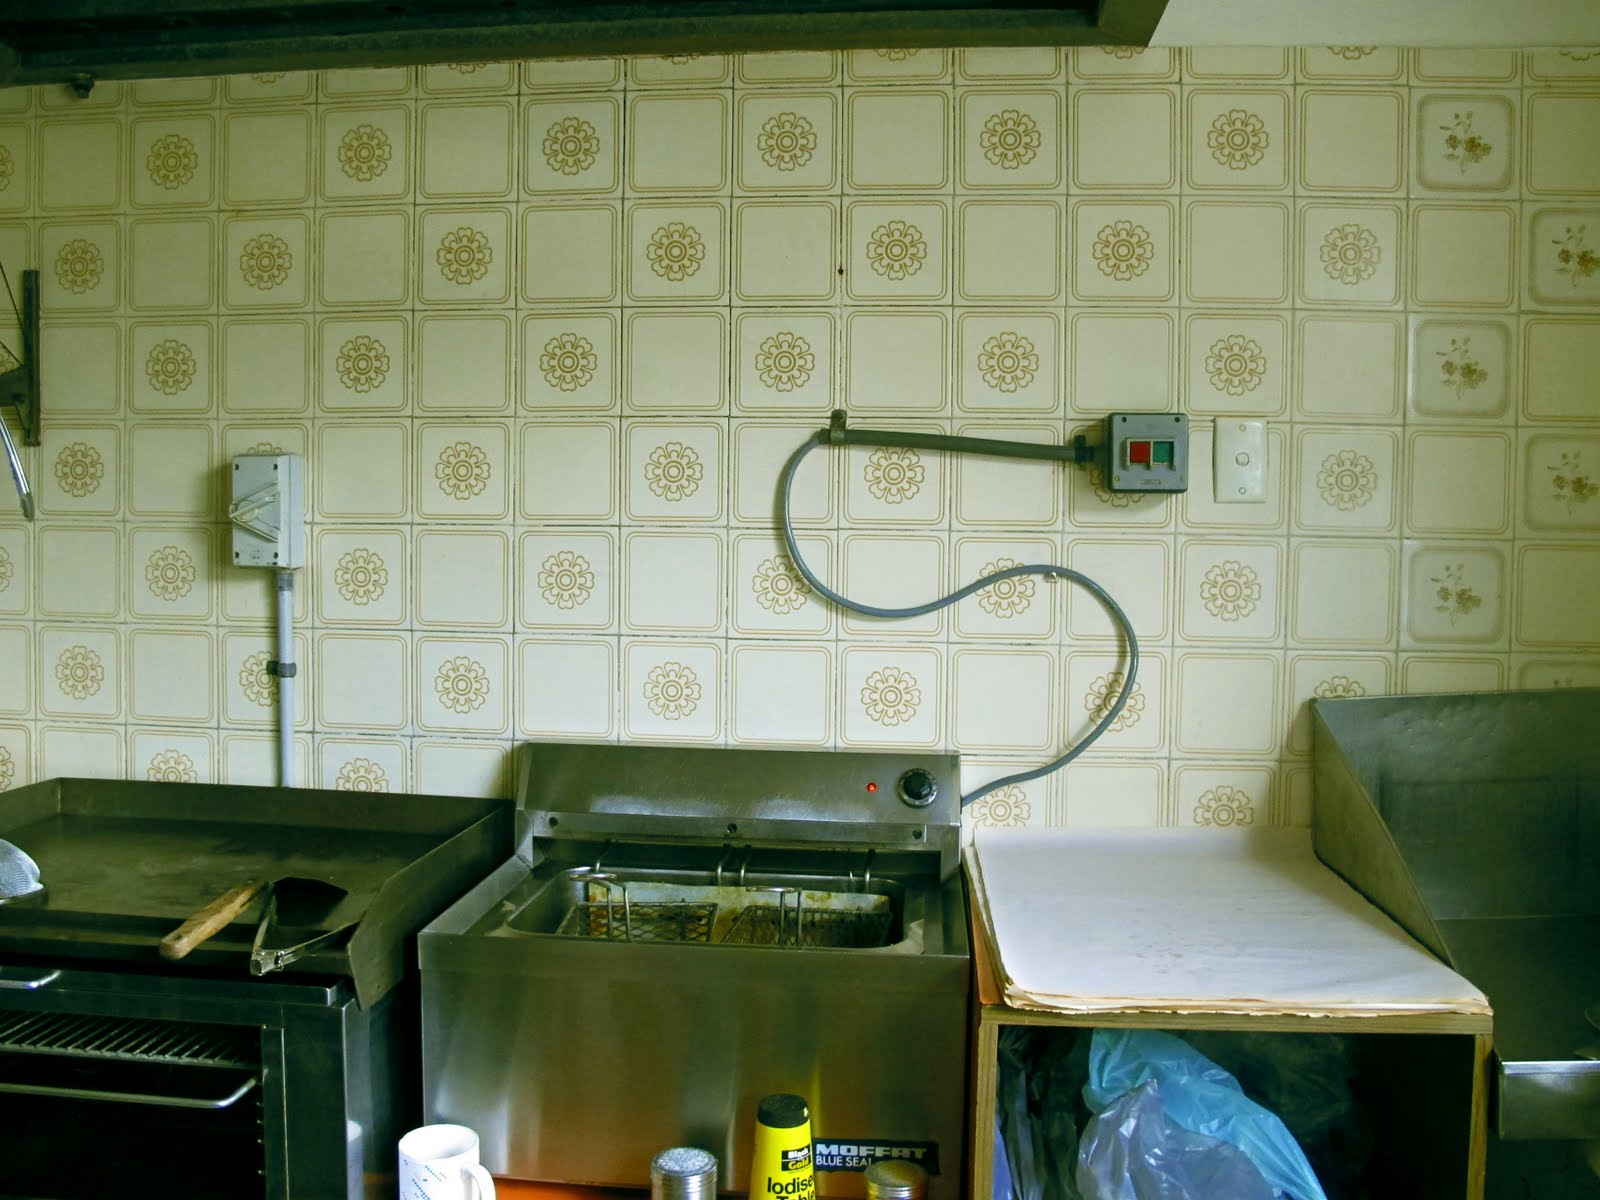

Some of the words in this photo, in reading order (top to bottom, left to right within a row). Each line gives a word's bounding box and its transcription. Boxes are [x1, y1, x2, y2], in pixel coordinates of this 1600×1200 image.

[788, 1147, 809, 1159] Black
[816, 1144, 927, 1158] MOFFAT
[788, 1158, 809, 1170] Gold
[816, 1156, 843, 1166] BLUE
